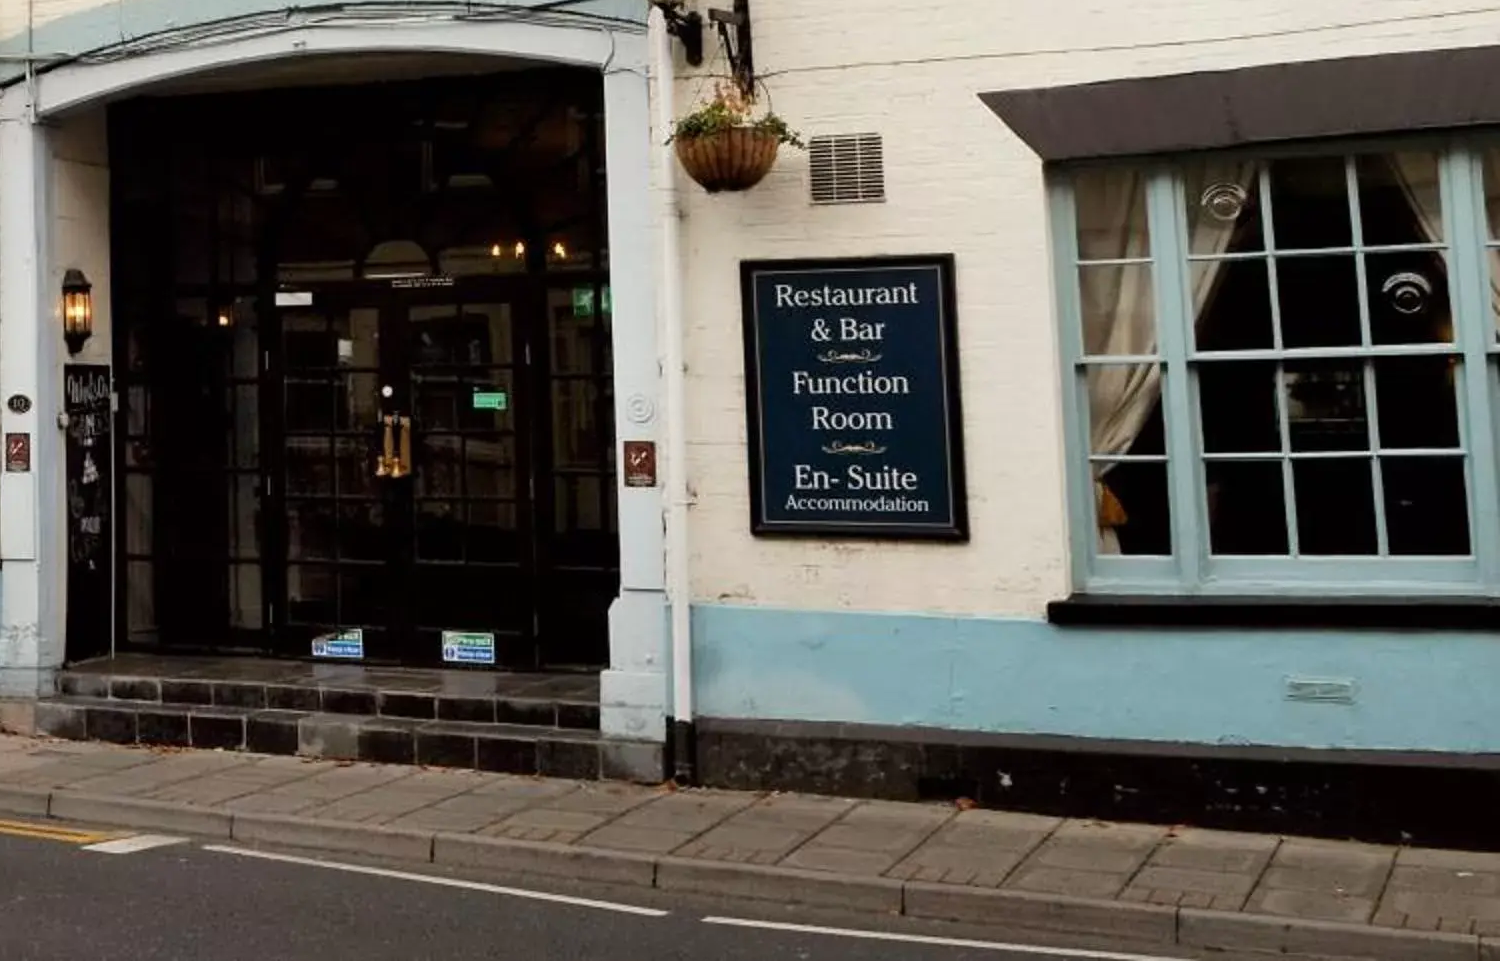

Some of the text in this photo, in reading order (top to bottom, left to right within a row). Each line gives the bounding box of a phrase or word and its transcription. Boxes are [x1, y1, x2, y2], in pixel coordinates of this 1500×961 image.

[775, 282, 919, 307] Restaurant
[810, 317, 886, 341] & Bar
[792, 370, 909, 394] Function
[812, 406, 893, 430] Room
[794, 464, 918, 490] En- Suite
[785, 494, 929, 512] Accommodation
